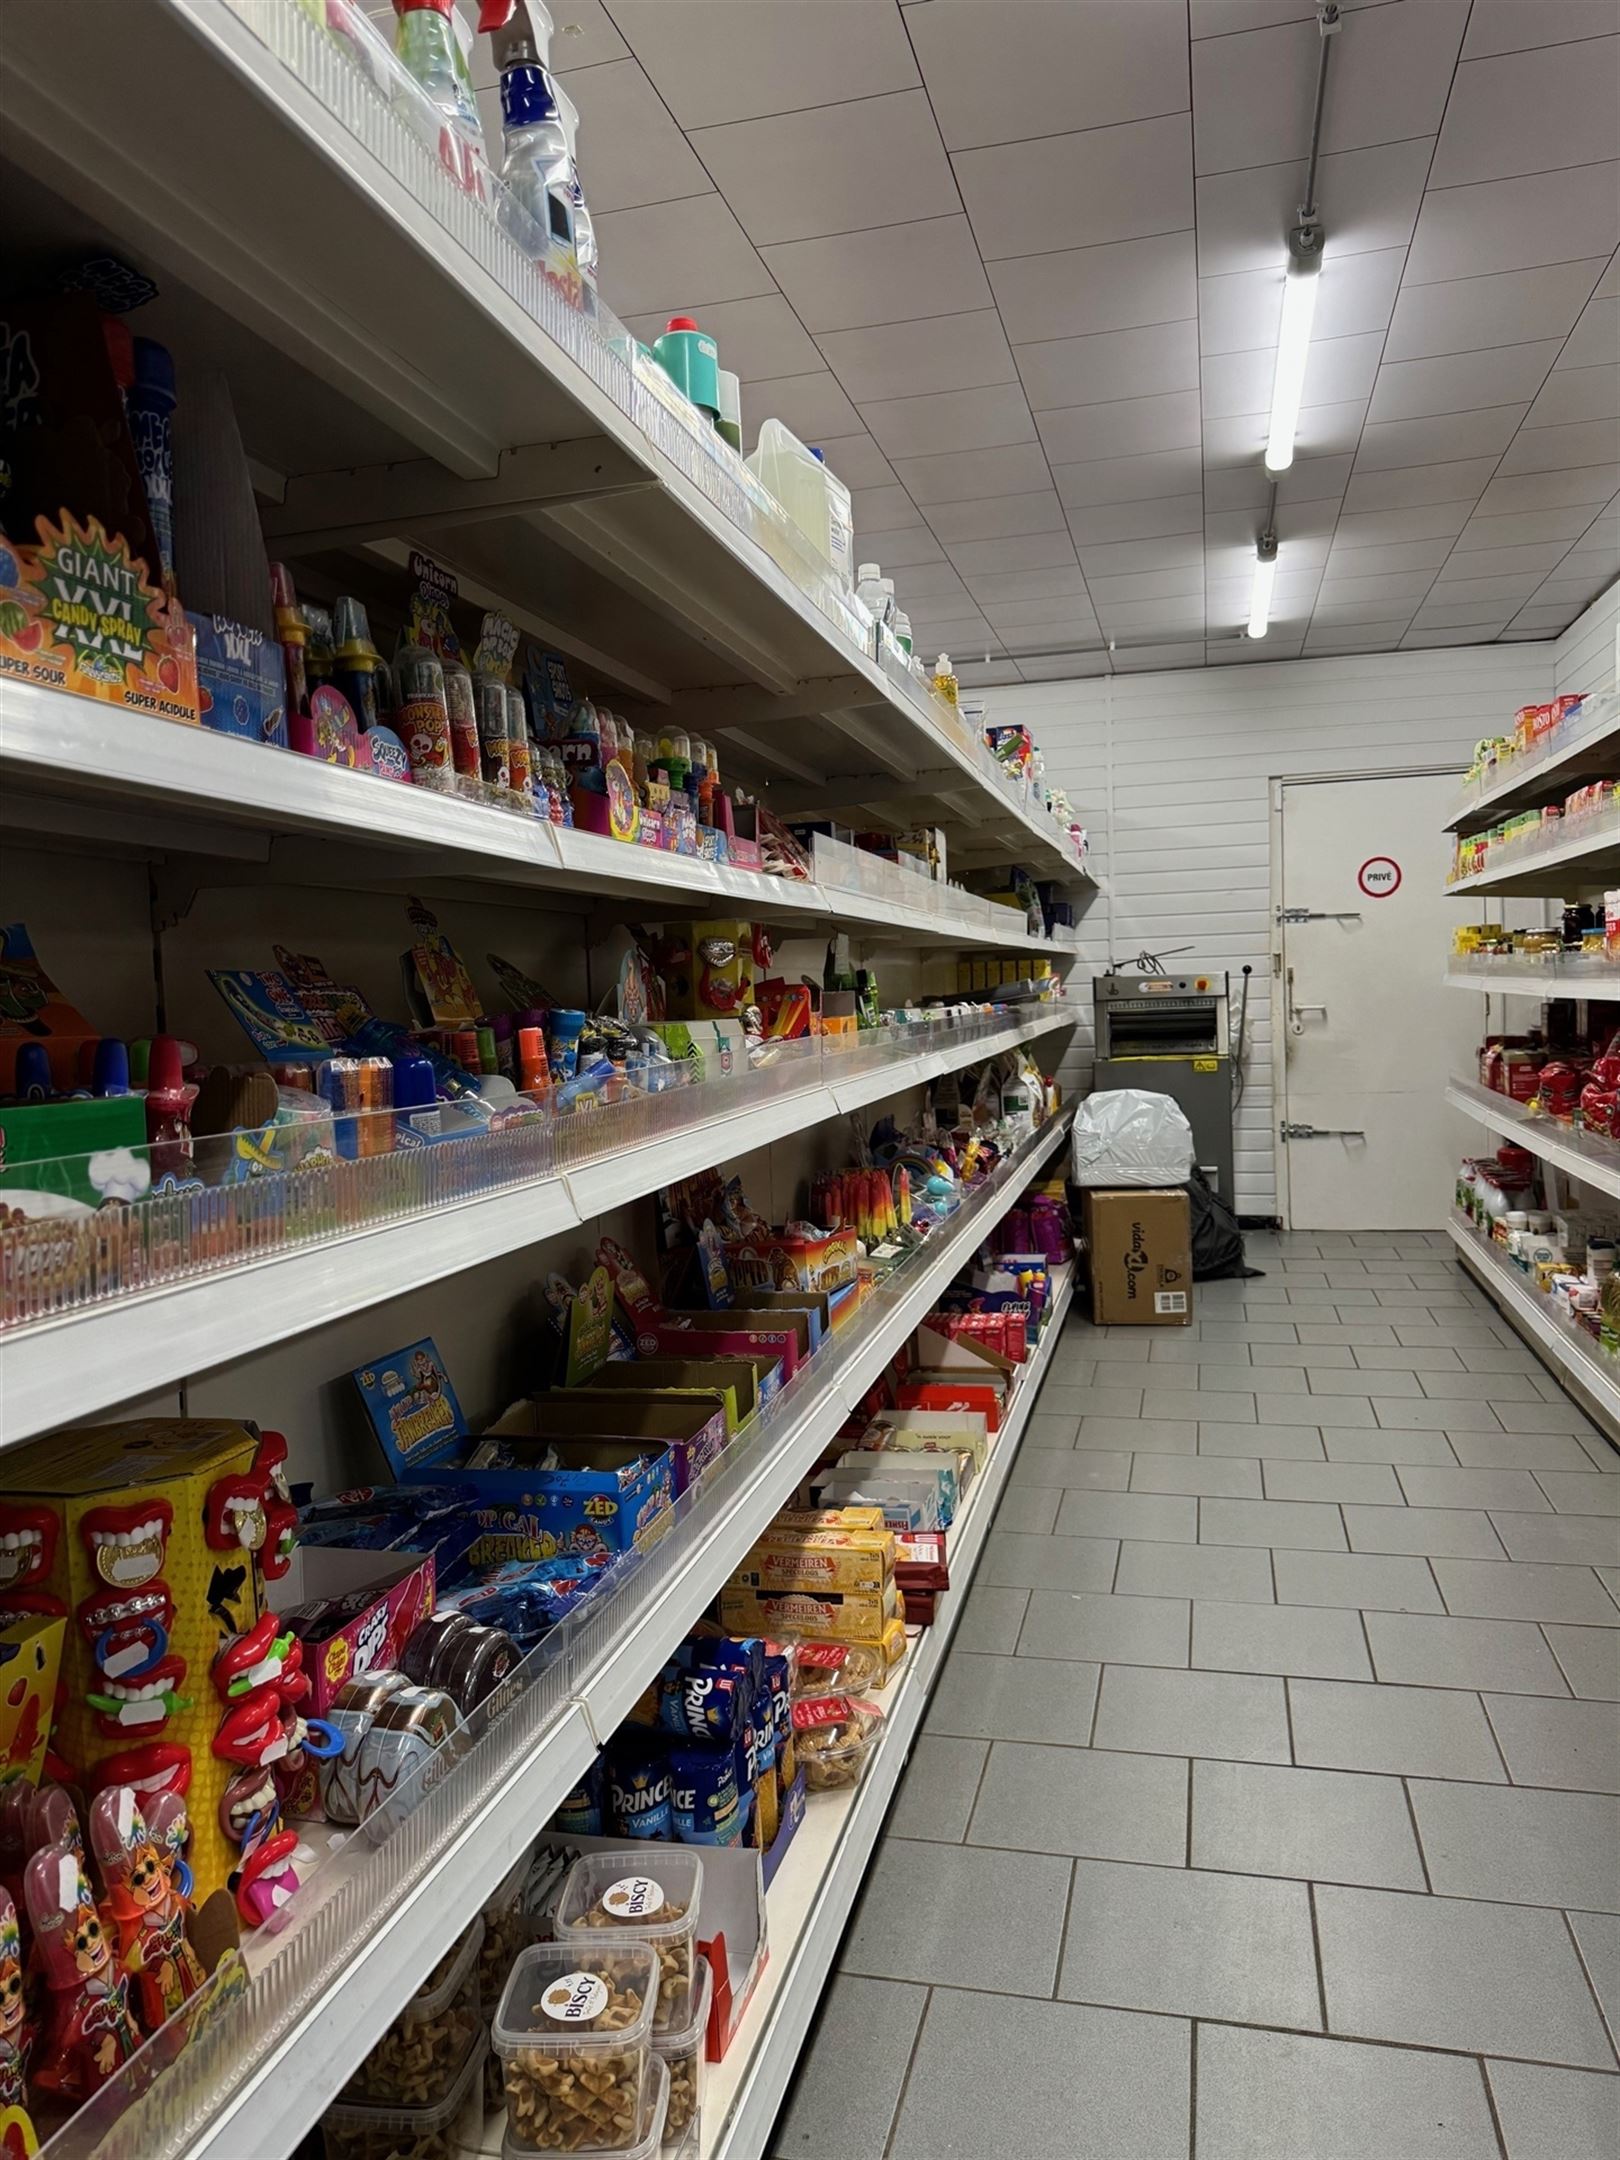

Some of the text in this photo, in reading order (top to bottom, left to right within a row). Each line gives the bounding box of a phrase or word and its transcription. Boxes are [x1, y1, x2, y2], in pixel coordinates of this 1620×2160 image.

[57, 547, 135, 596] GIANT
[52, 598, 143, 646] CANDY SPRAY
[0, 655, 29, 676] UPER
[32, 664, 67, 685] SOUR
[124, 690, 196, 721] SUPER ACIDULE
[413, 718, 443, 733] POP
[1367, 871, 1392, 882] PRIVÉ
[583, 1500, 620, 1517] ZED
[771, 1556, 828, 1569] VERMEIREN
[771, 1602, 828, 1615] VERMEIREN
[611, 1773, 673, 1813] PRINCE
